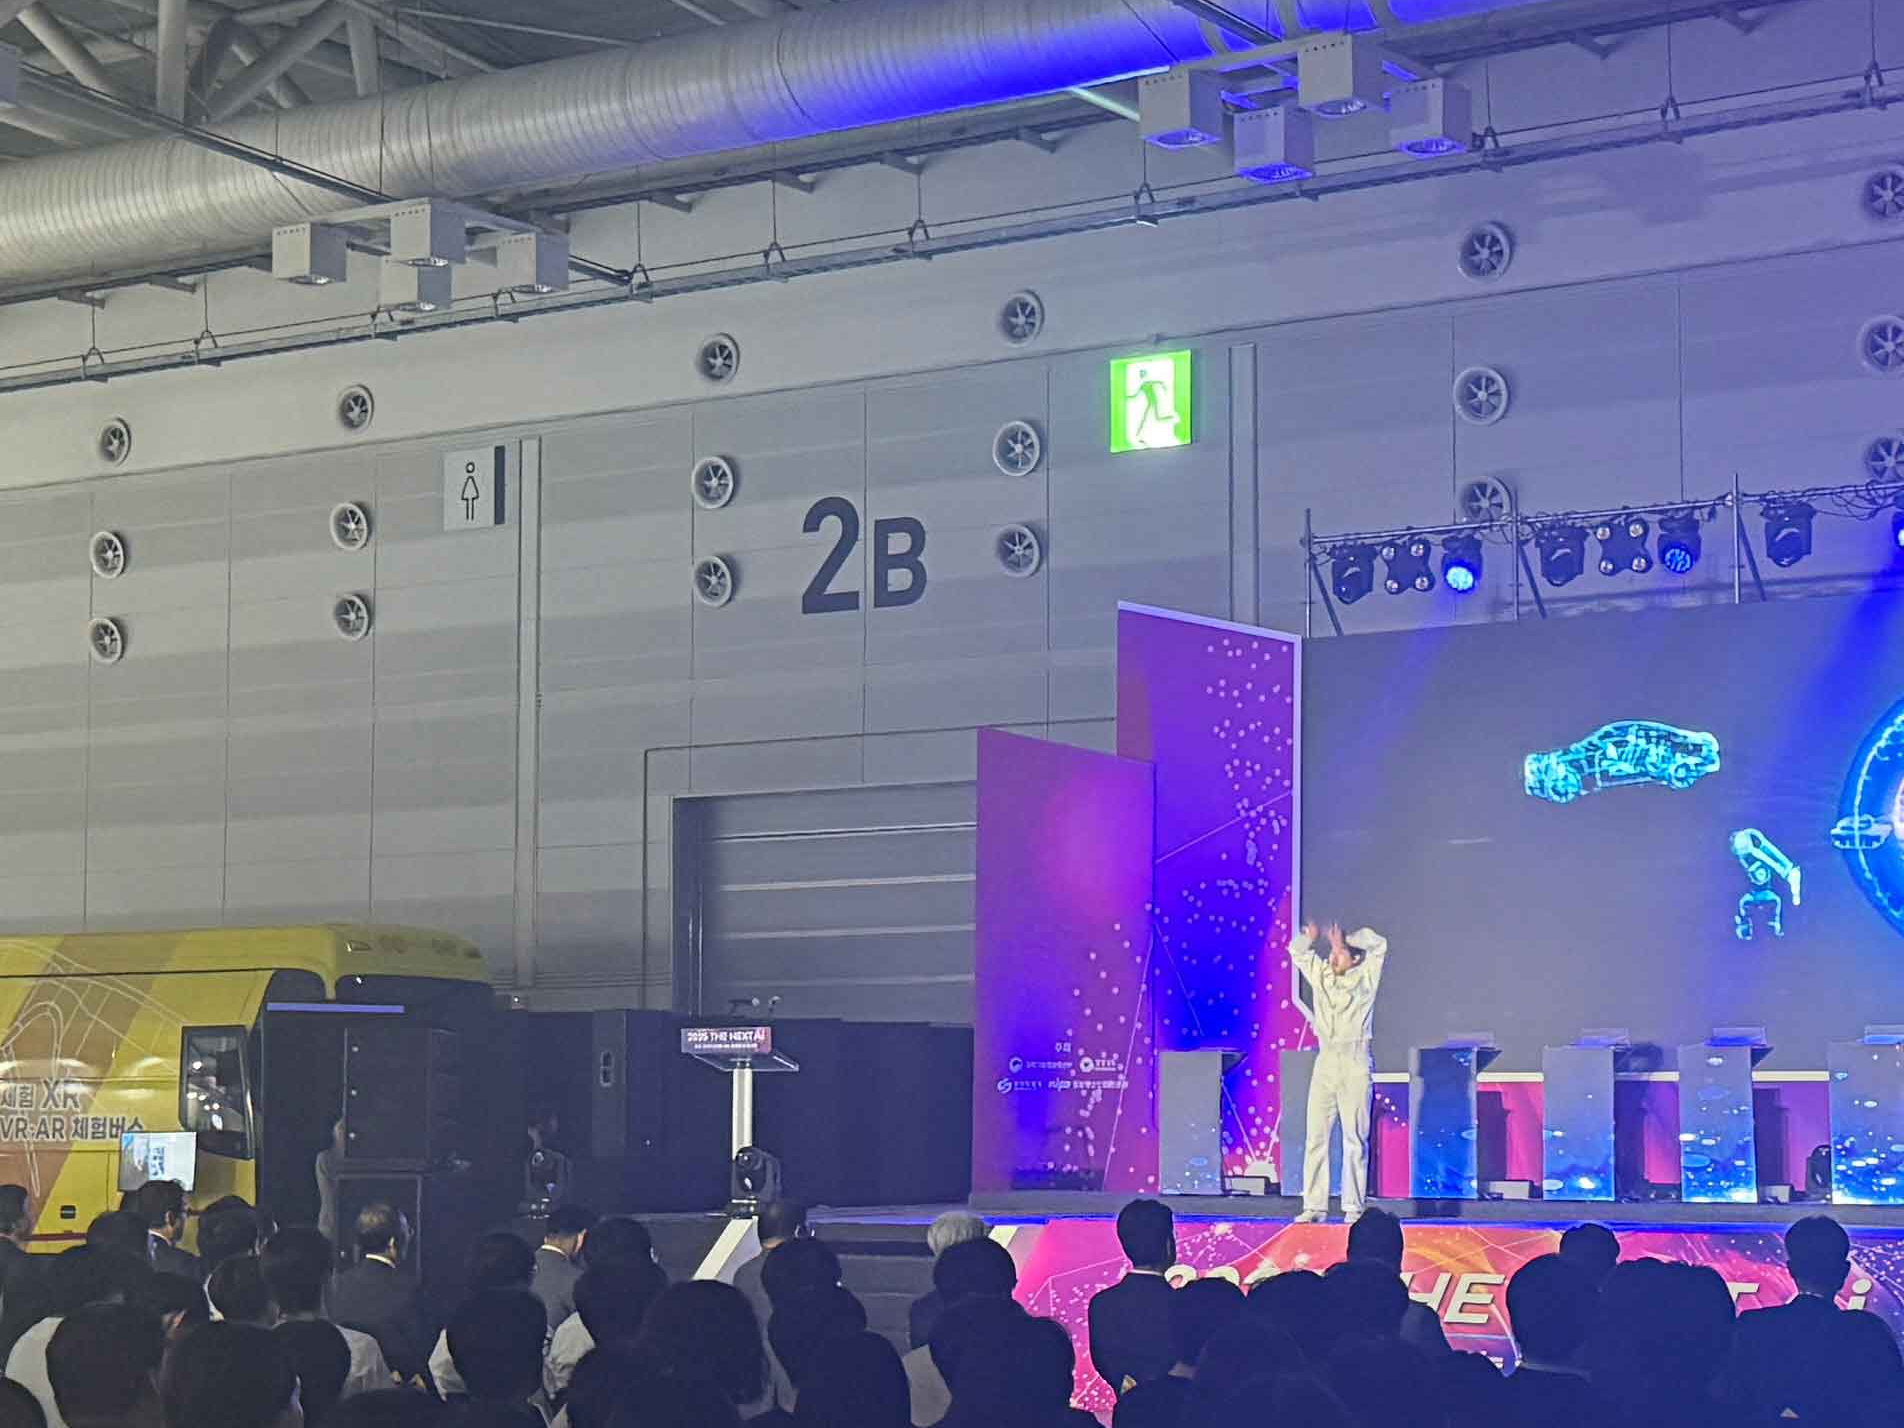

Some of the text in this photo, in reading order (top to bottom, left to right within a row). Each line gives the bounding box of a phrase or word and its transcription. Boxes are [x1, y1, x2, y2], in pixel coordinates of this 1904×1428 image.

[801, 496, 928, 614] 2B
[41, 1079, 81, 1110] XR
[71, 1115, 145, 1140] 체험버스
[1399, 1271, 1506, 1324] HE
